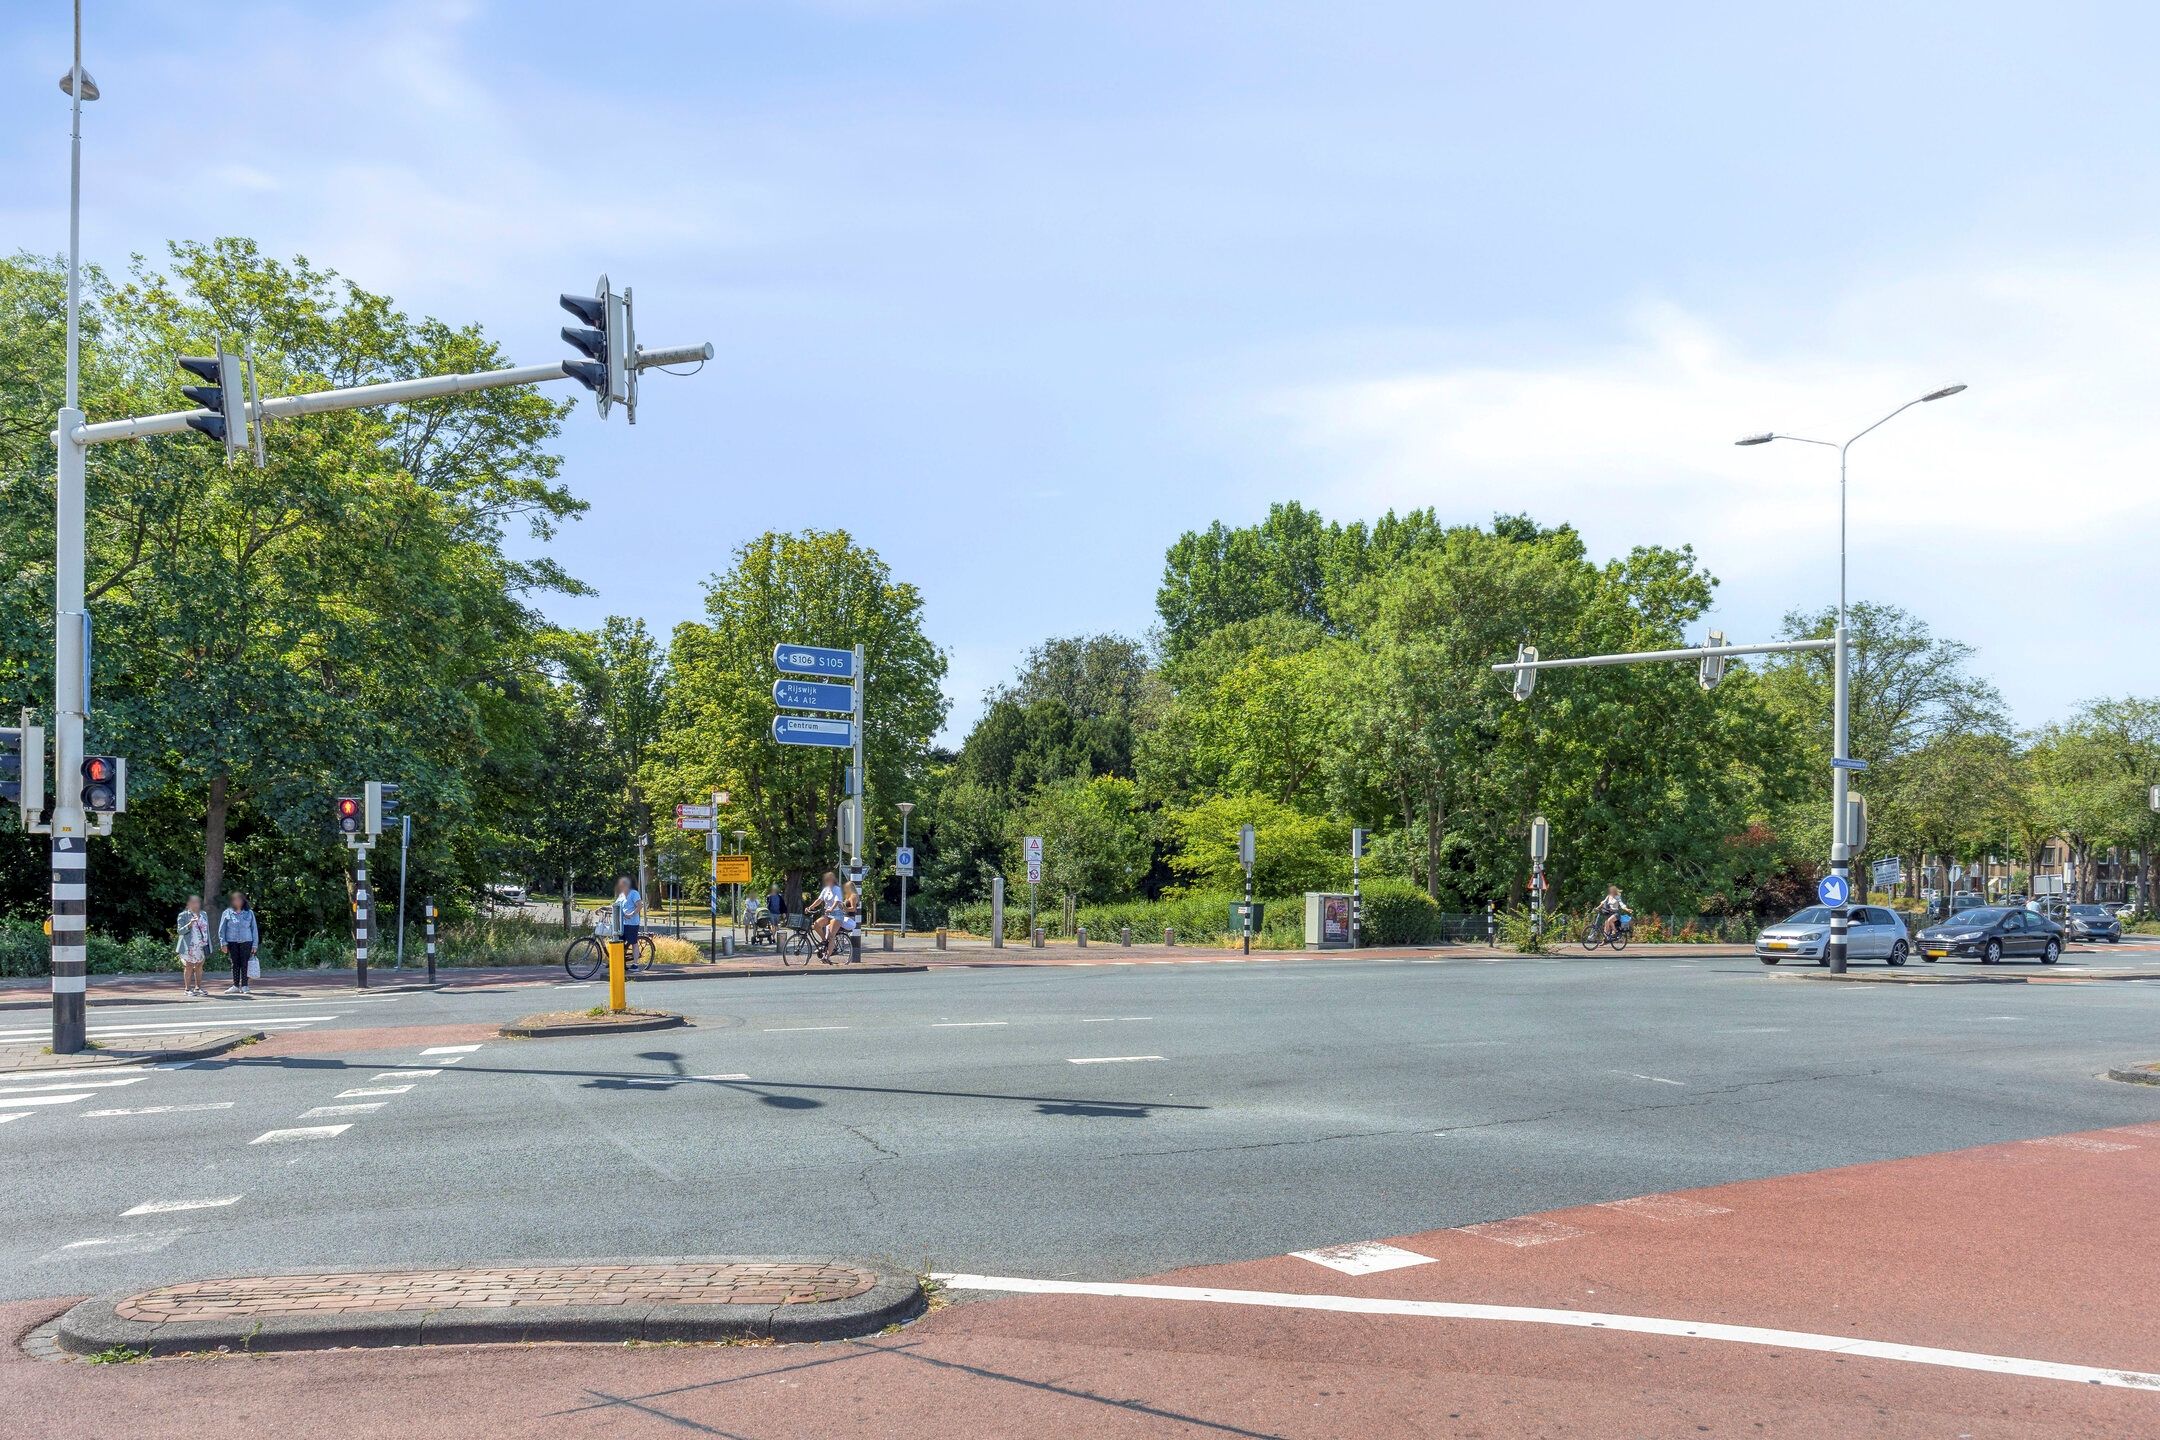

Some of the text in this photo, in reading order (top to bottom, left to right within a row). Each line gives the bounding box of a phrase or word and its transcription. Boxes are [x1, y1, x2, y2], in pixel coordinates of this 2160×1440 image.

[792, 655, 844, 668] S106 S105
[787, 684, 817, 696] Rijswijk
[787, 695, 817, 705] A4 A12
[788, 721, 819, 730] Centrum
